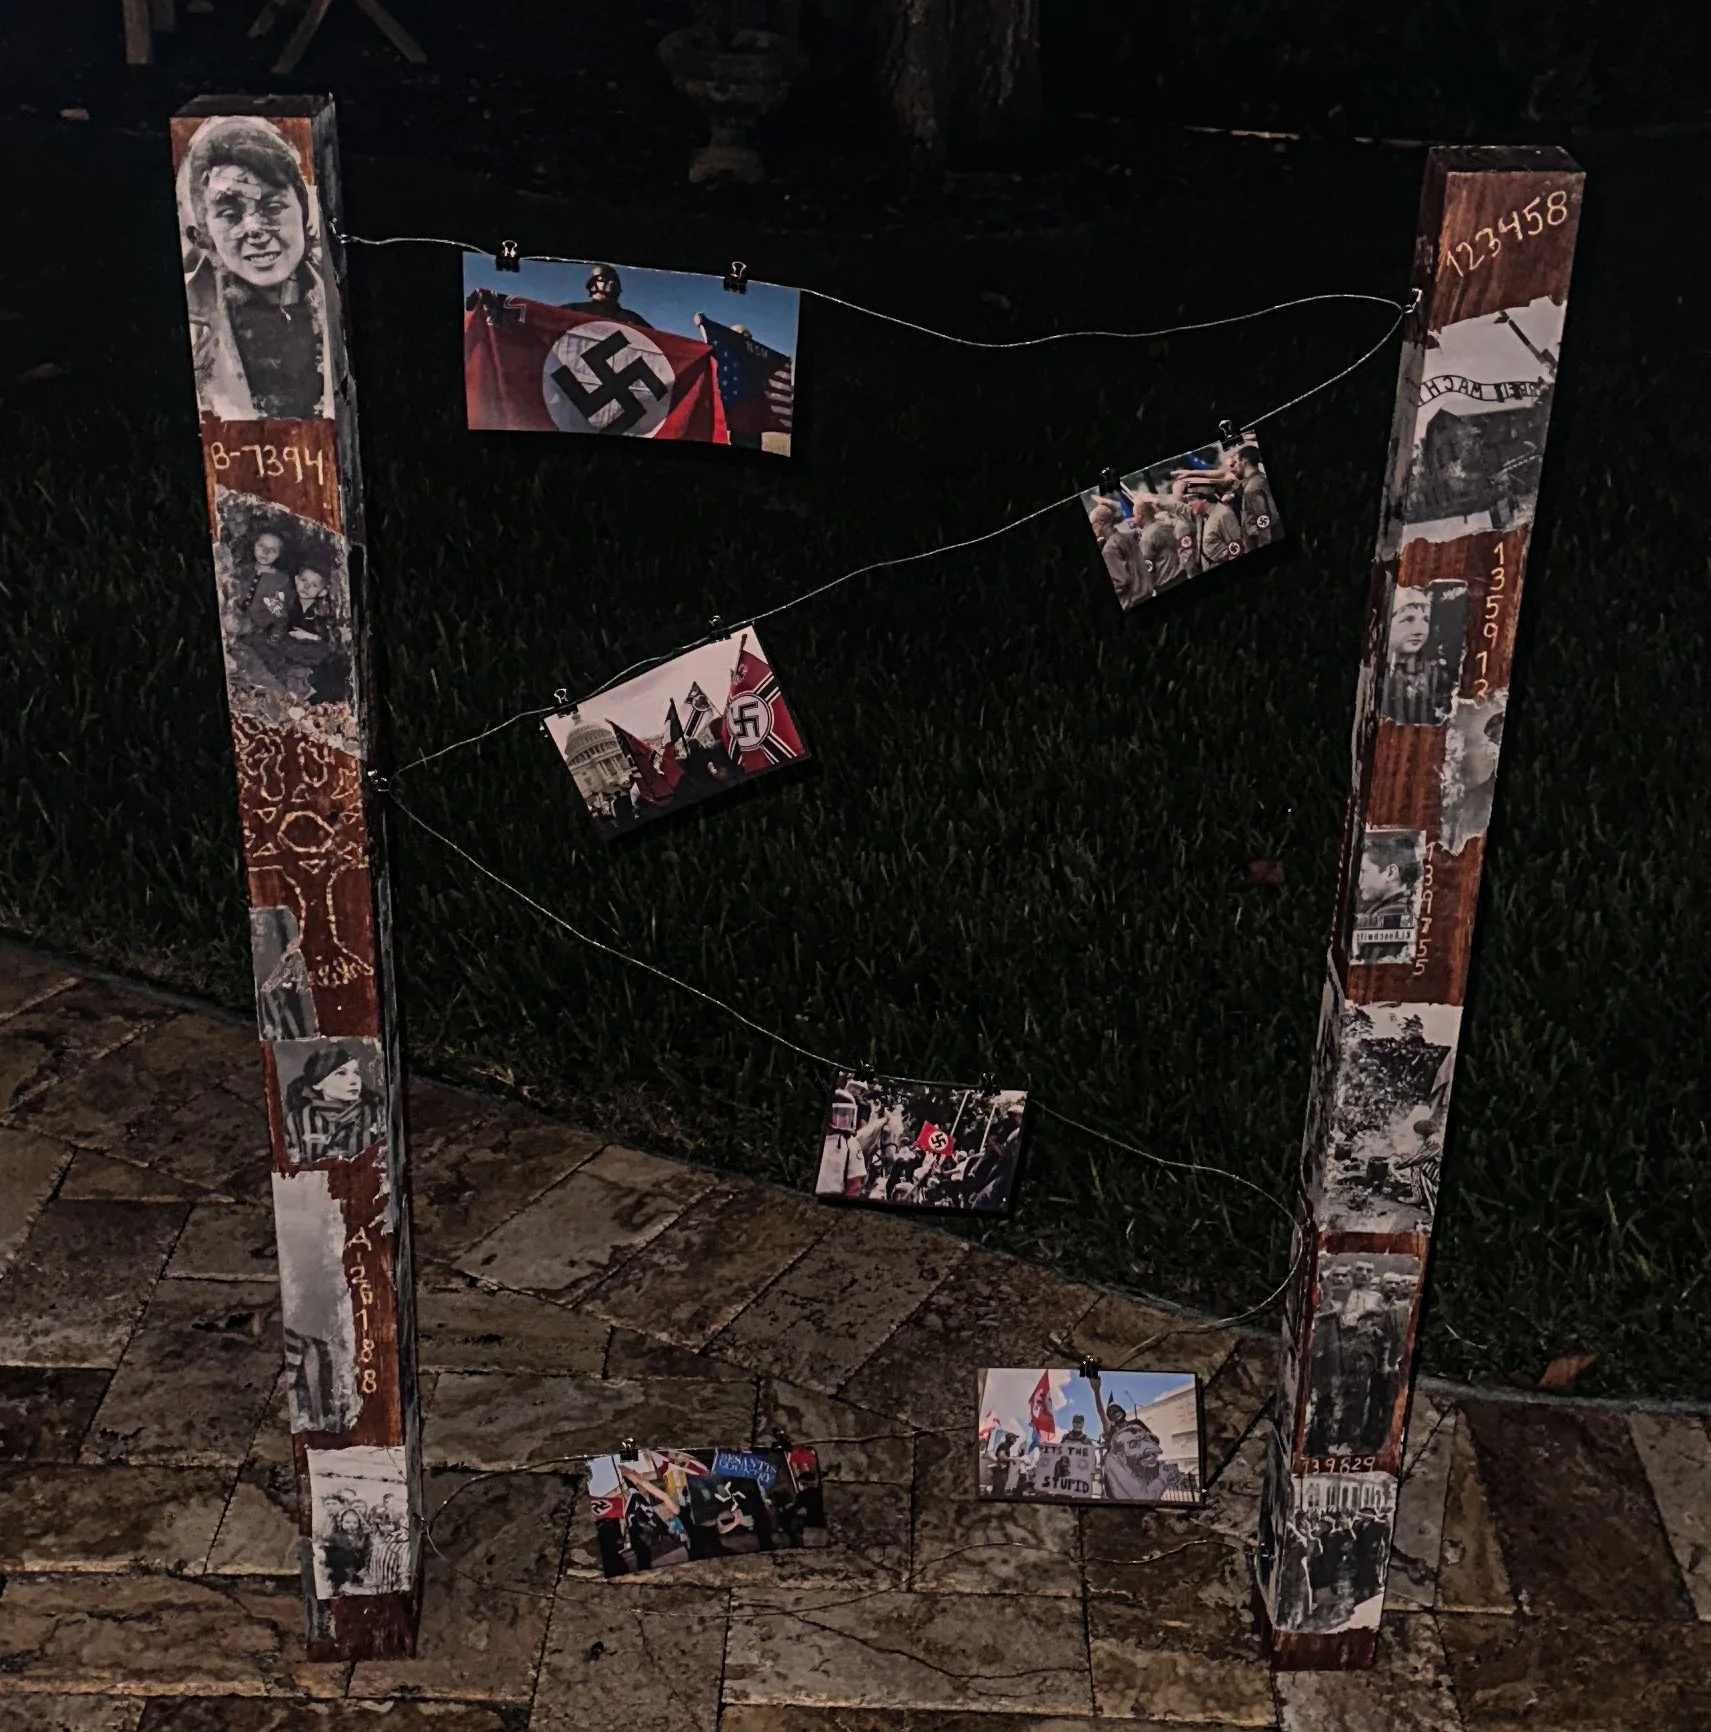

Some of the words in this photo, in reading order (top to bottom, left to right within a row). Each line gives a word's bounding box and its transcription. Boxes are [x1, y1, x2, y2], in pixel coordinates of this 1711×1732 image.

[1446, 190, 1568, 278] 123458
[210, 441, 324, 486] B-7394
[1473, 541, 1506, 701] 135912
[1068, 1446, 1089, 1457] THE
[1042, 1475, 1090, 1494] STUPID
